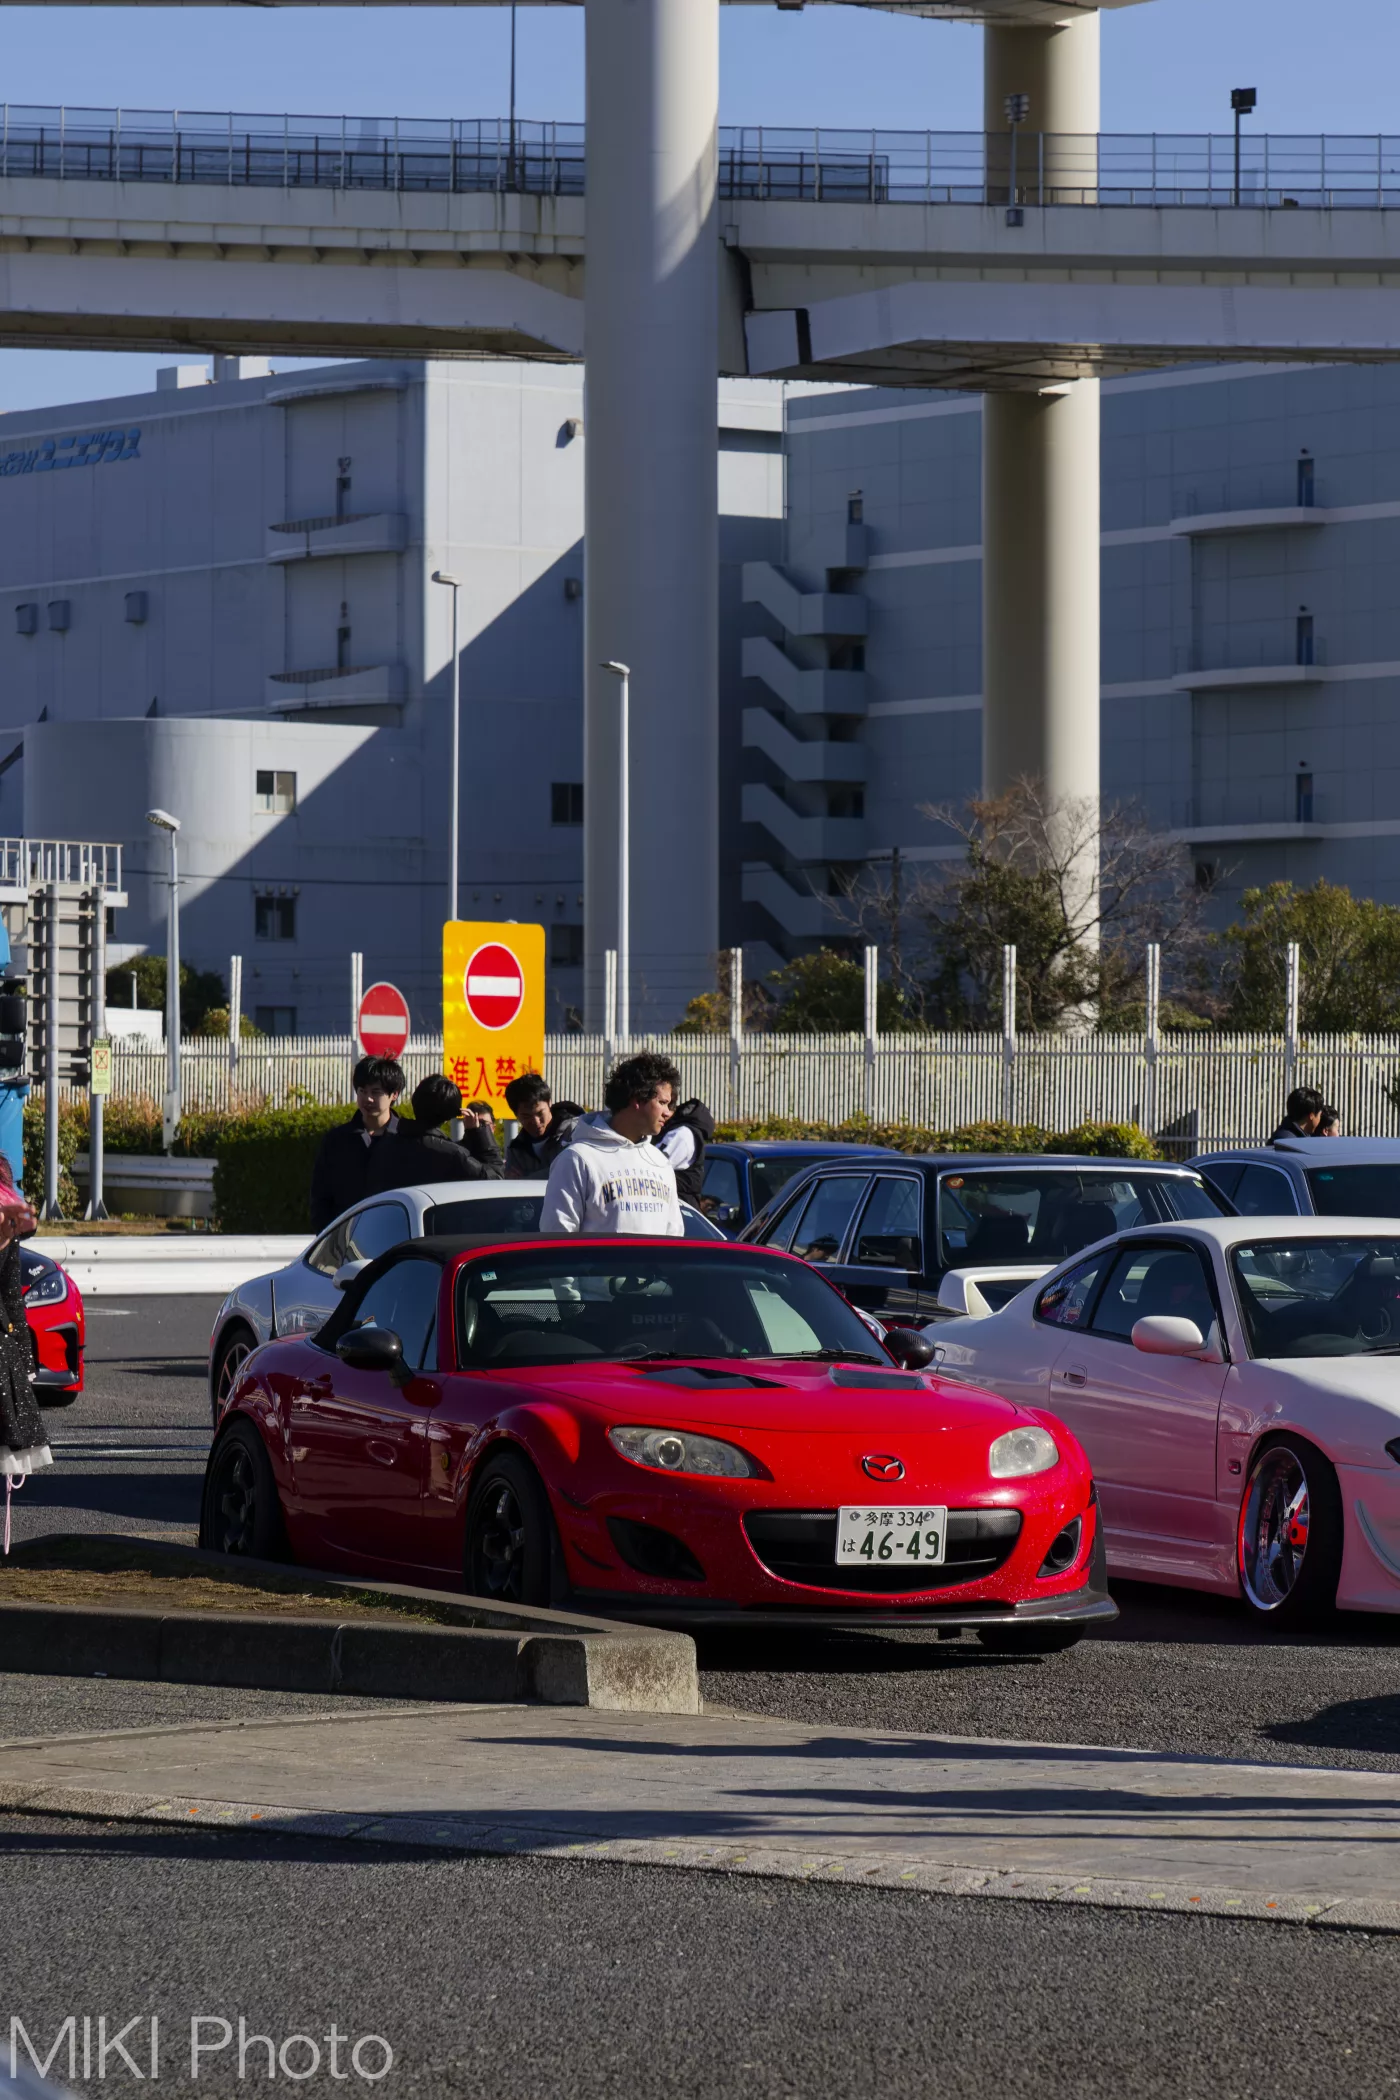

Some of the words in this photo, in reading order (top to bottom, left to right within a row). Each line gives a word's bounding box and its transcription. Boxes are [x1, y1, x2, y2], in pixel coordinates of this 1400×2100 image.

[602, 1179, 624, 1204] NEW
[620, 1201, 664, 1213] UNIVERSITY
[864, 1511, 894, 1527] 多摩
[897, 1511, 924, 1527] 334
[842, 1538, 857, 1553] は
[859, 1530, 940, 1561] 46-49
